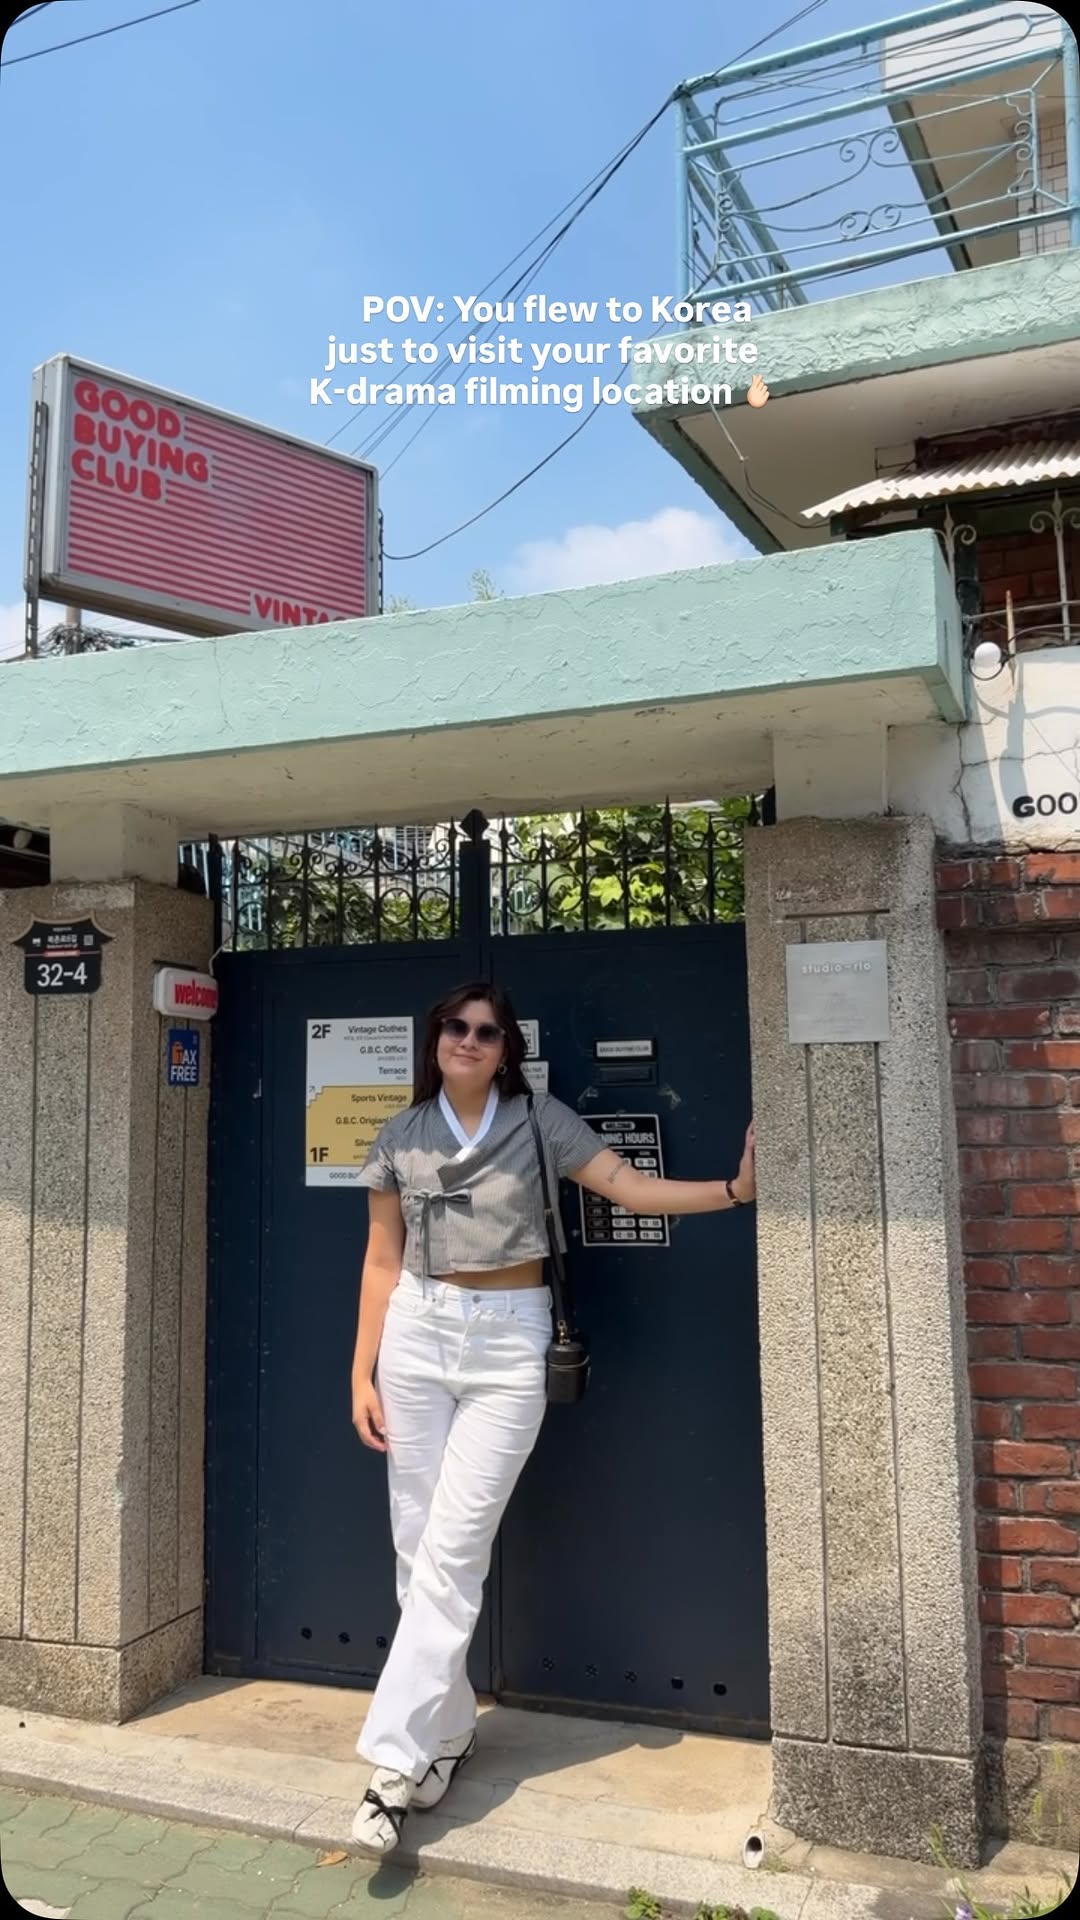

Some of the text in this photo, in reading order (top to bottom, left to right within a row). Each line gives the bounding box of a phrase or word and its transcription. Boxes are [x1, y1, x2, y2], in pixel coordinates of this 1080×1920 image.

[74, 379, 181, 439] GOOD
[74, 413, 209, 483] BUYING
[71, 448, 162, 501] CLUB
[255, 592, 344, 626] VINTA
[1012, 792, 1080, 818] GOO
[36, 962, 88, 987] 32-4
[801, 962, 872, 974] studio-rio
[175, 978, 217, 1008] welcom
[311, 1024, 331, 1039] 2F
[348, 1024, 407, 1035] Vintage Clothes
[174, 1049, 197, 1065] TAX
[360, 1045, 407, 1054] G.B.C. Office
[170, 1065, 197, 1082] FREE
[378, 1067, 407, 1075] Terrace
[351, 1094, 407, 1103] Sports Vintage
[335, 1116, 359, 1125] G.B.C.
[598, 1132, 656, 1144] NING HOURS
[310, 1147, 329, 1162] 1F
